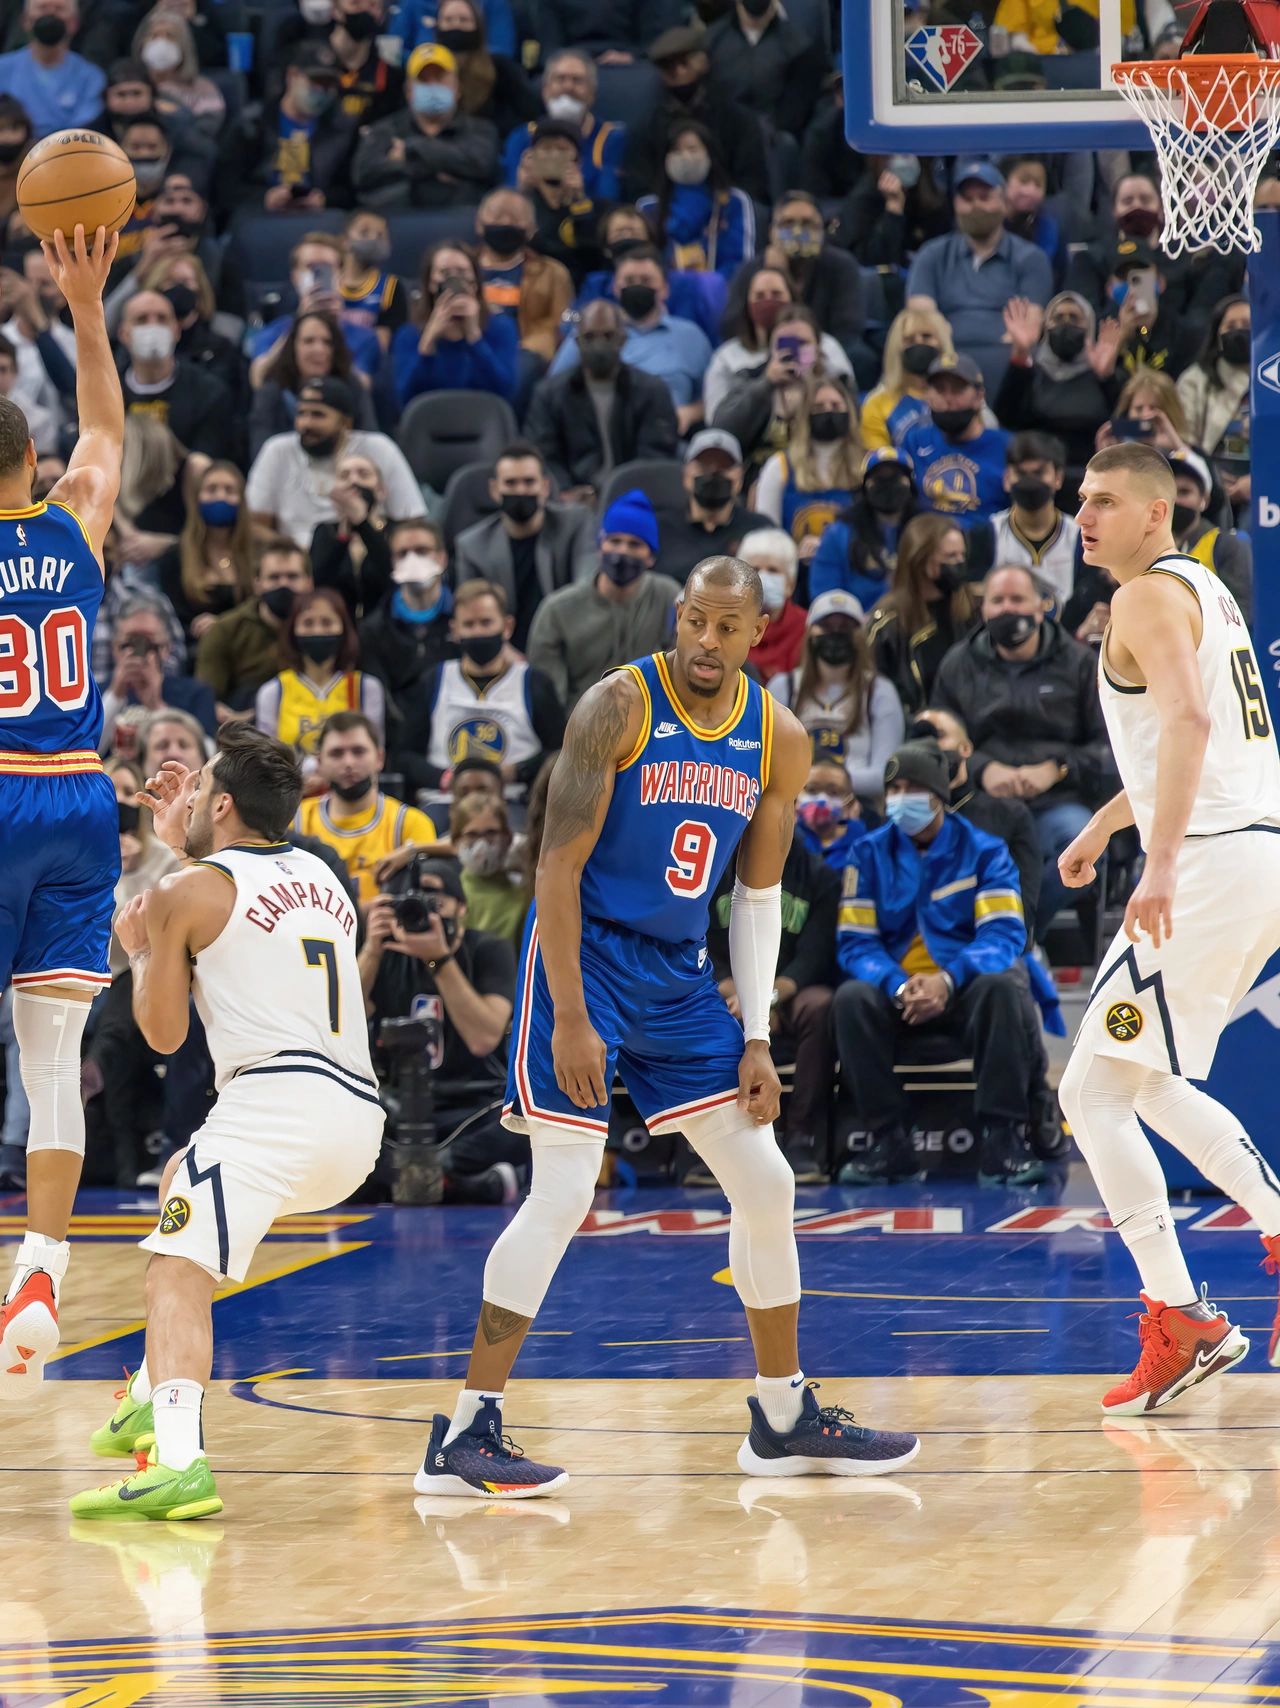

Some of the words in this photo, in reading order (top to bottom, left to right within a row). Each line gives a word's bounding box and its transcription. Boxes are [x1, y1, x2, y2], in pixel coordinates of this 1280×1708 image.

[950, 34, 966, 56] 75
[1230, 647, 1270, 741] 15
[658, 721, 678, 733] NIKE
[728, 737, 761, 749] Rakuten
[640, 760, 759, 822] WARRIORS
[665, 819, 718, 899] 9
[245, 881, 355, 937] CAMPAZZO
[299, 936, 342, 1036] 7
